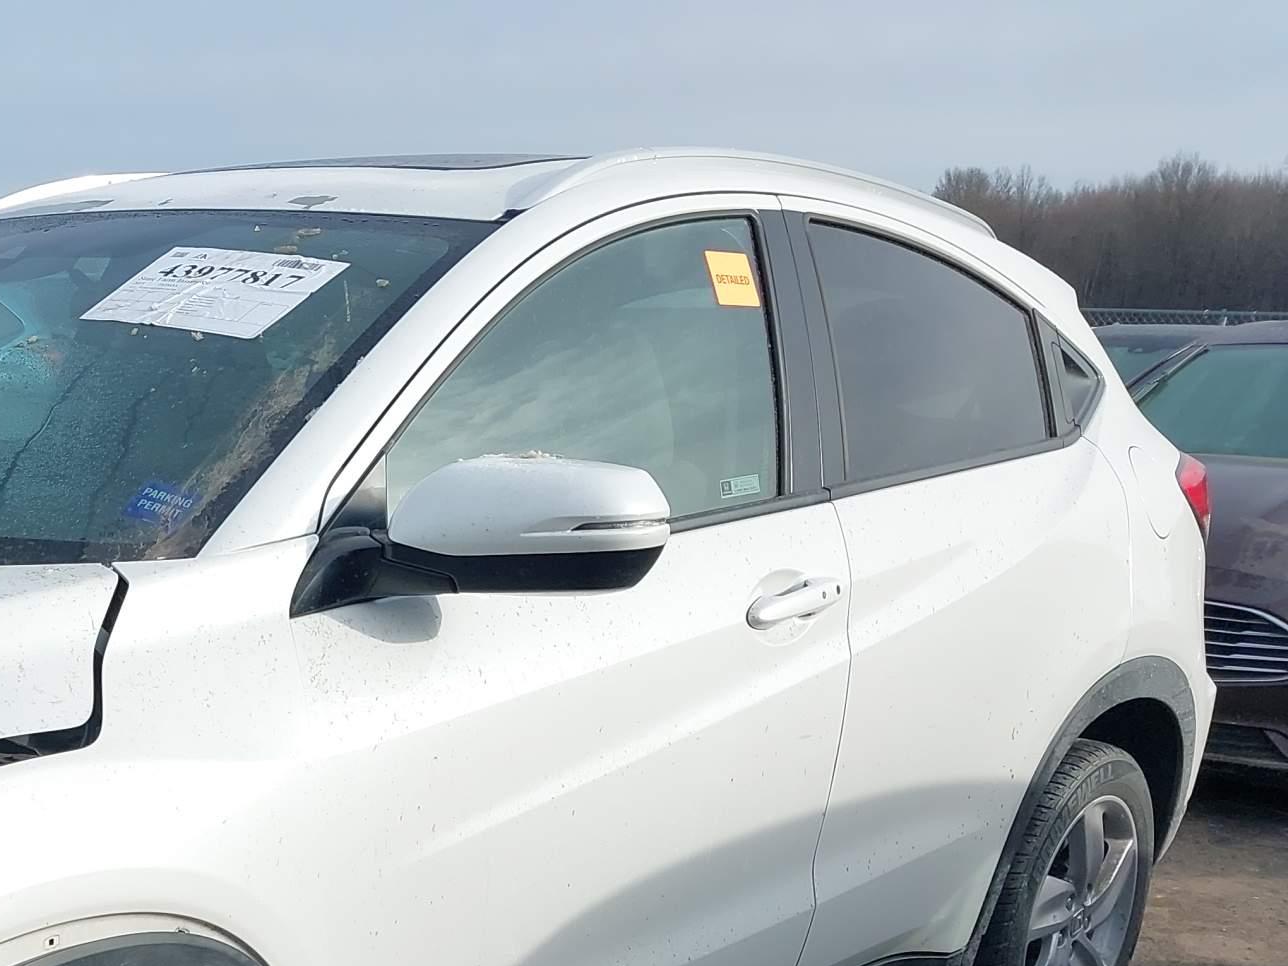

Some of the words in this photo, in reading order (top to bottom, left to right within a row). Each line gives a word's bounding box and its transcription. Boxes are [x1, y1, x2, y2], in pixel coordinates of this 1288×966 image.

[158, 264, 306, 288] 43977817
[716, 273, 750, 286] DETAILED
[136, 498, 183, 519] PERMIT
[142, 487, 193, 509] PARKING
